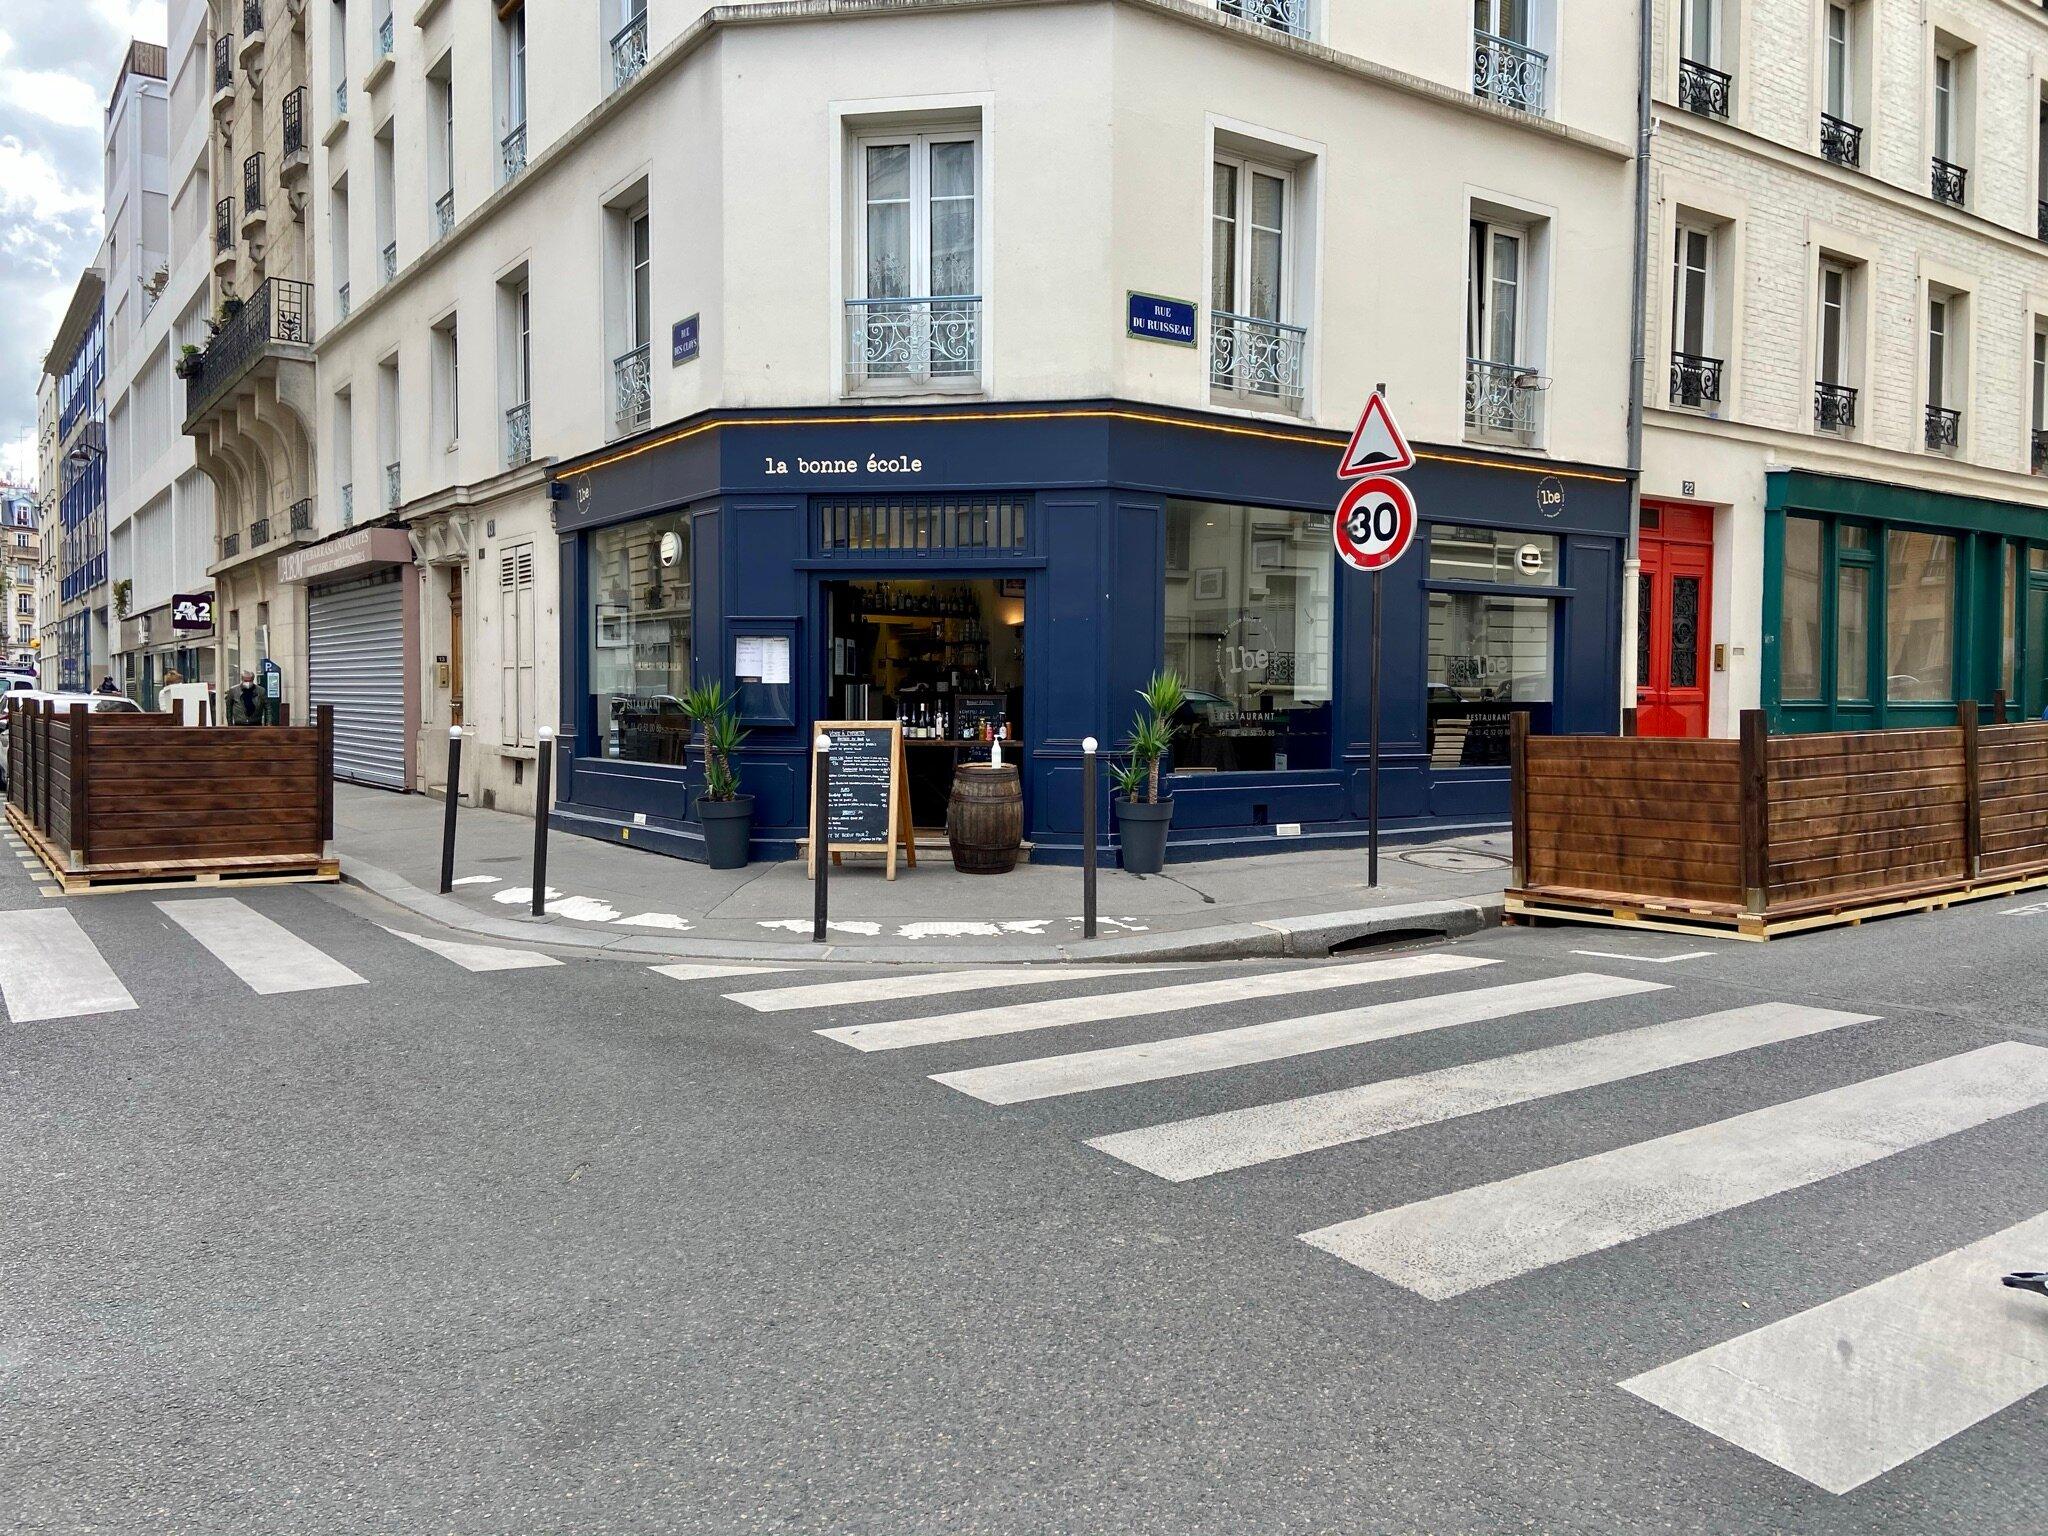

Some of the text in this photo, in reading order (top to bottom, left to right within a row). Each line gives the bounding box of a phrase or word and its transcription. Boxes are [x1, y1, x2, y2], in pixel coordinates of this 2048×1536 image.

[1154, 305, 1172, 318] RUE
[1133, 316, 1192, 336] DU RUISSEAU
[765, 453, 922, 474] la bonne école
[1684, 482, 1694, 494] 22
[1540, 490, 1561, 504] lbe
[1347, 501, 1398, 545] 30
[1225, 645, 1269, 674] lbe
[1474, 654, 1508, 679] lbe
[1219, 712, 1275, 721] RESTAURANT
[1466, 713, 1510, 722] RESTAURANT
